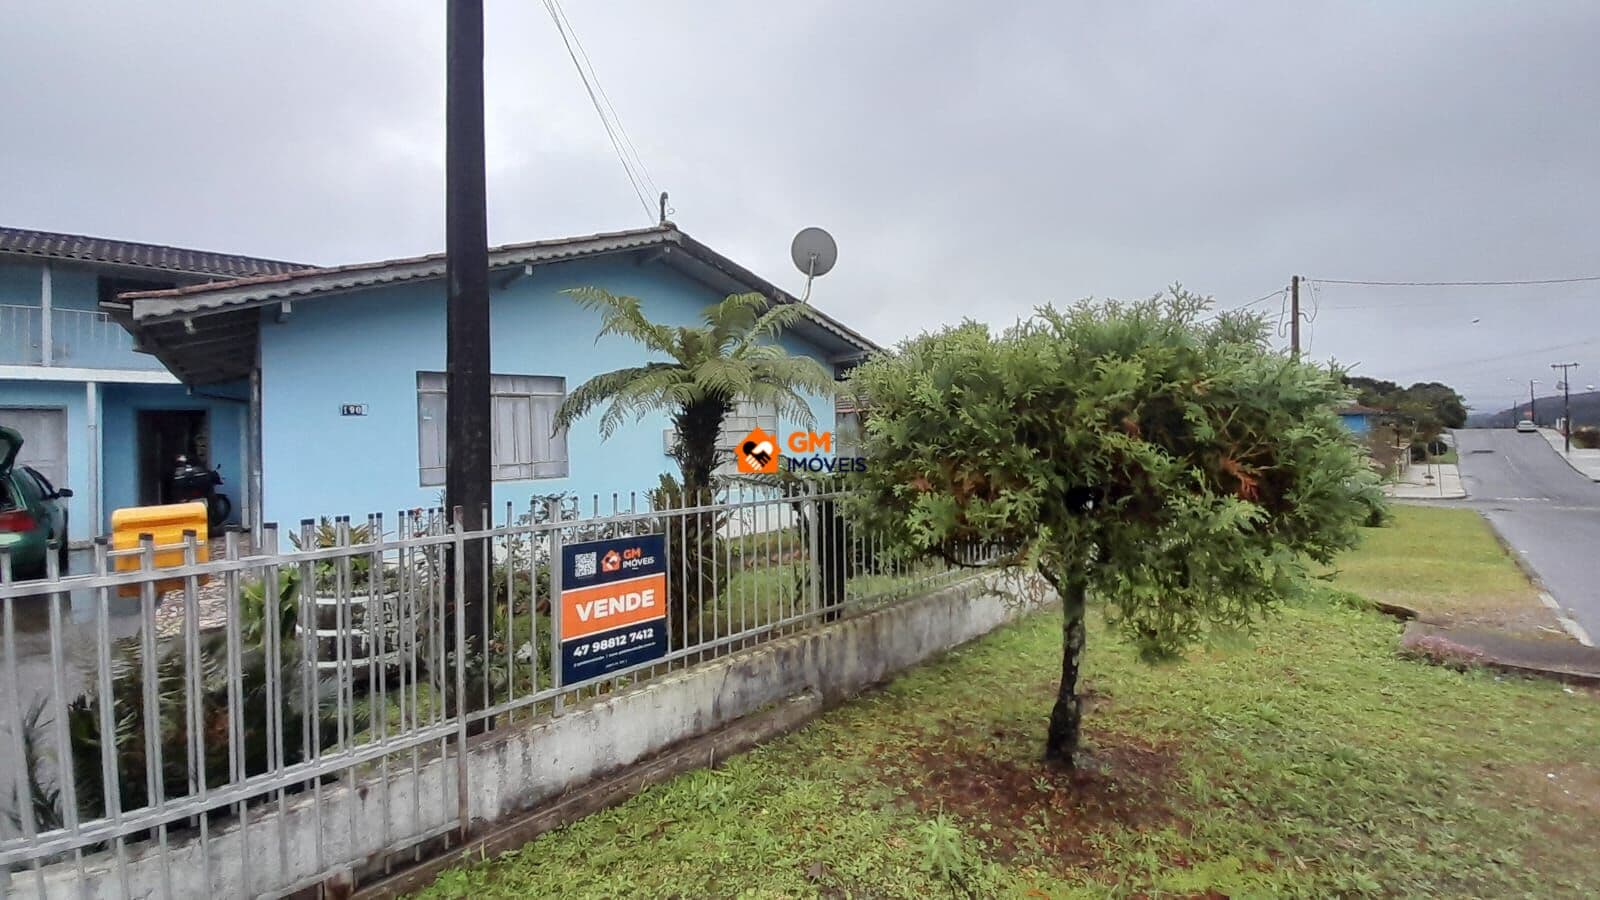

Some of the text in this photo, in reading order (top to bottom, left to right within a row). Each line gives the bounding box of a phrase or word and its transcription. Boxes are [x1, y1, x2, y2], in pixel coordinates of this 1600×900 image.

[622, 556, 655, 569] IMÓVEIS
[623, 547, 641, 559] GM
[575, 589, 655, 622] VENDE
[573, 644, 590, 657] 47
[592, 634, 627, 653] 98812
[628, 628, 654, 643] 7412
